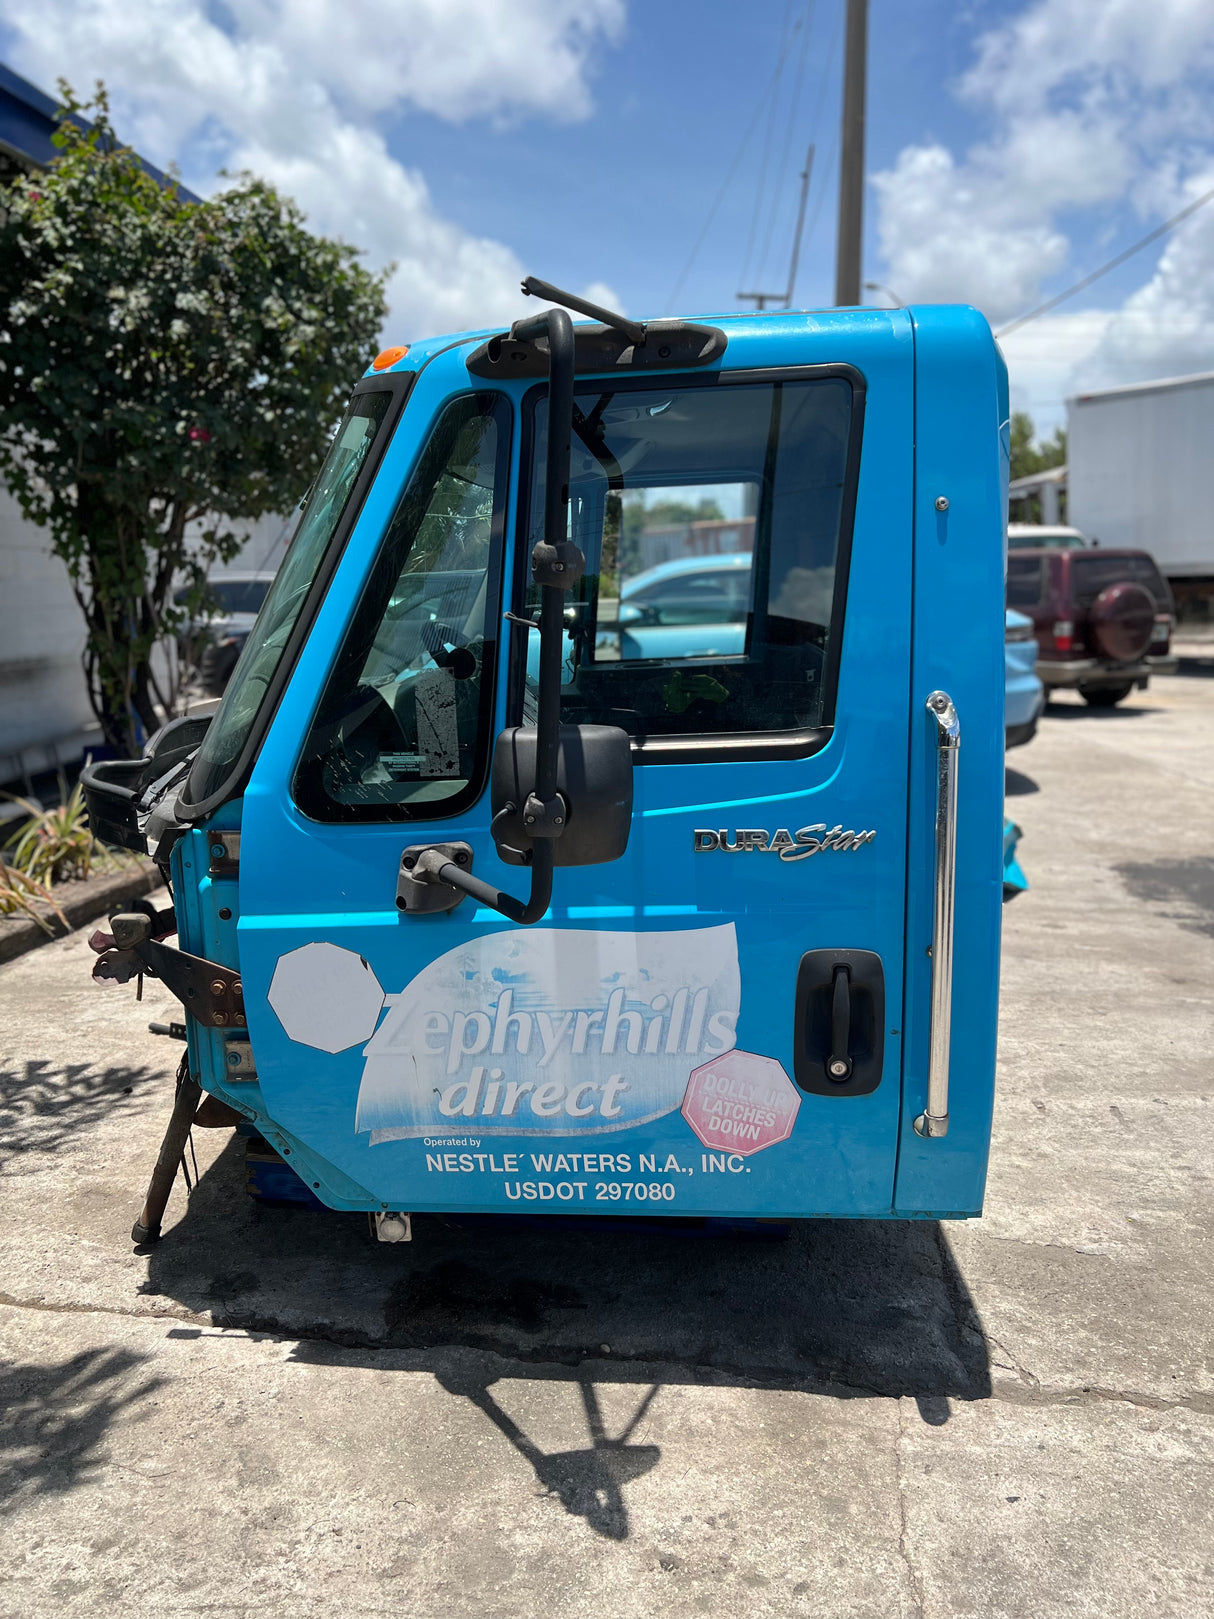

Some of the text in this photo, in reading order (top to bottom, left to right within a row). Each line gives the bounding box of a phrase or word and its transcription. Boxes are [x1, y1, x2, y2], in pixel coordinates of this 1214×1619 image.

[363, 988, 740, 1073] Zephyrhills
[437, 1066, 631, 1119] direct
[702, 1073, 758, 1102] DOLLY
[701, 1097, 777, 1127] LATCHES
[708, 1116, 761, 1141] DOWN
[424, 1137, 482, 1149] Operated by
[531, 1154, 632, 1173] WATERS
[639, 1154, 694, 1176] N.A.,
[701, 1154, 752, 1174] INC.
[504, 1182, 676, 1201] USDOT 297080
